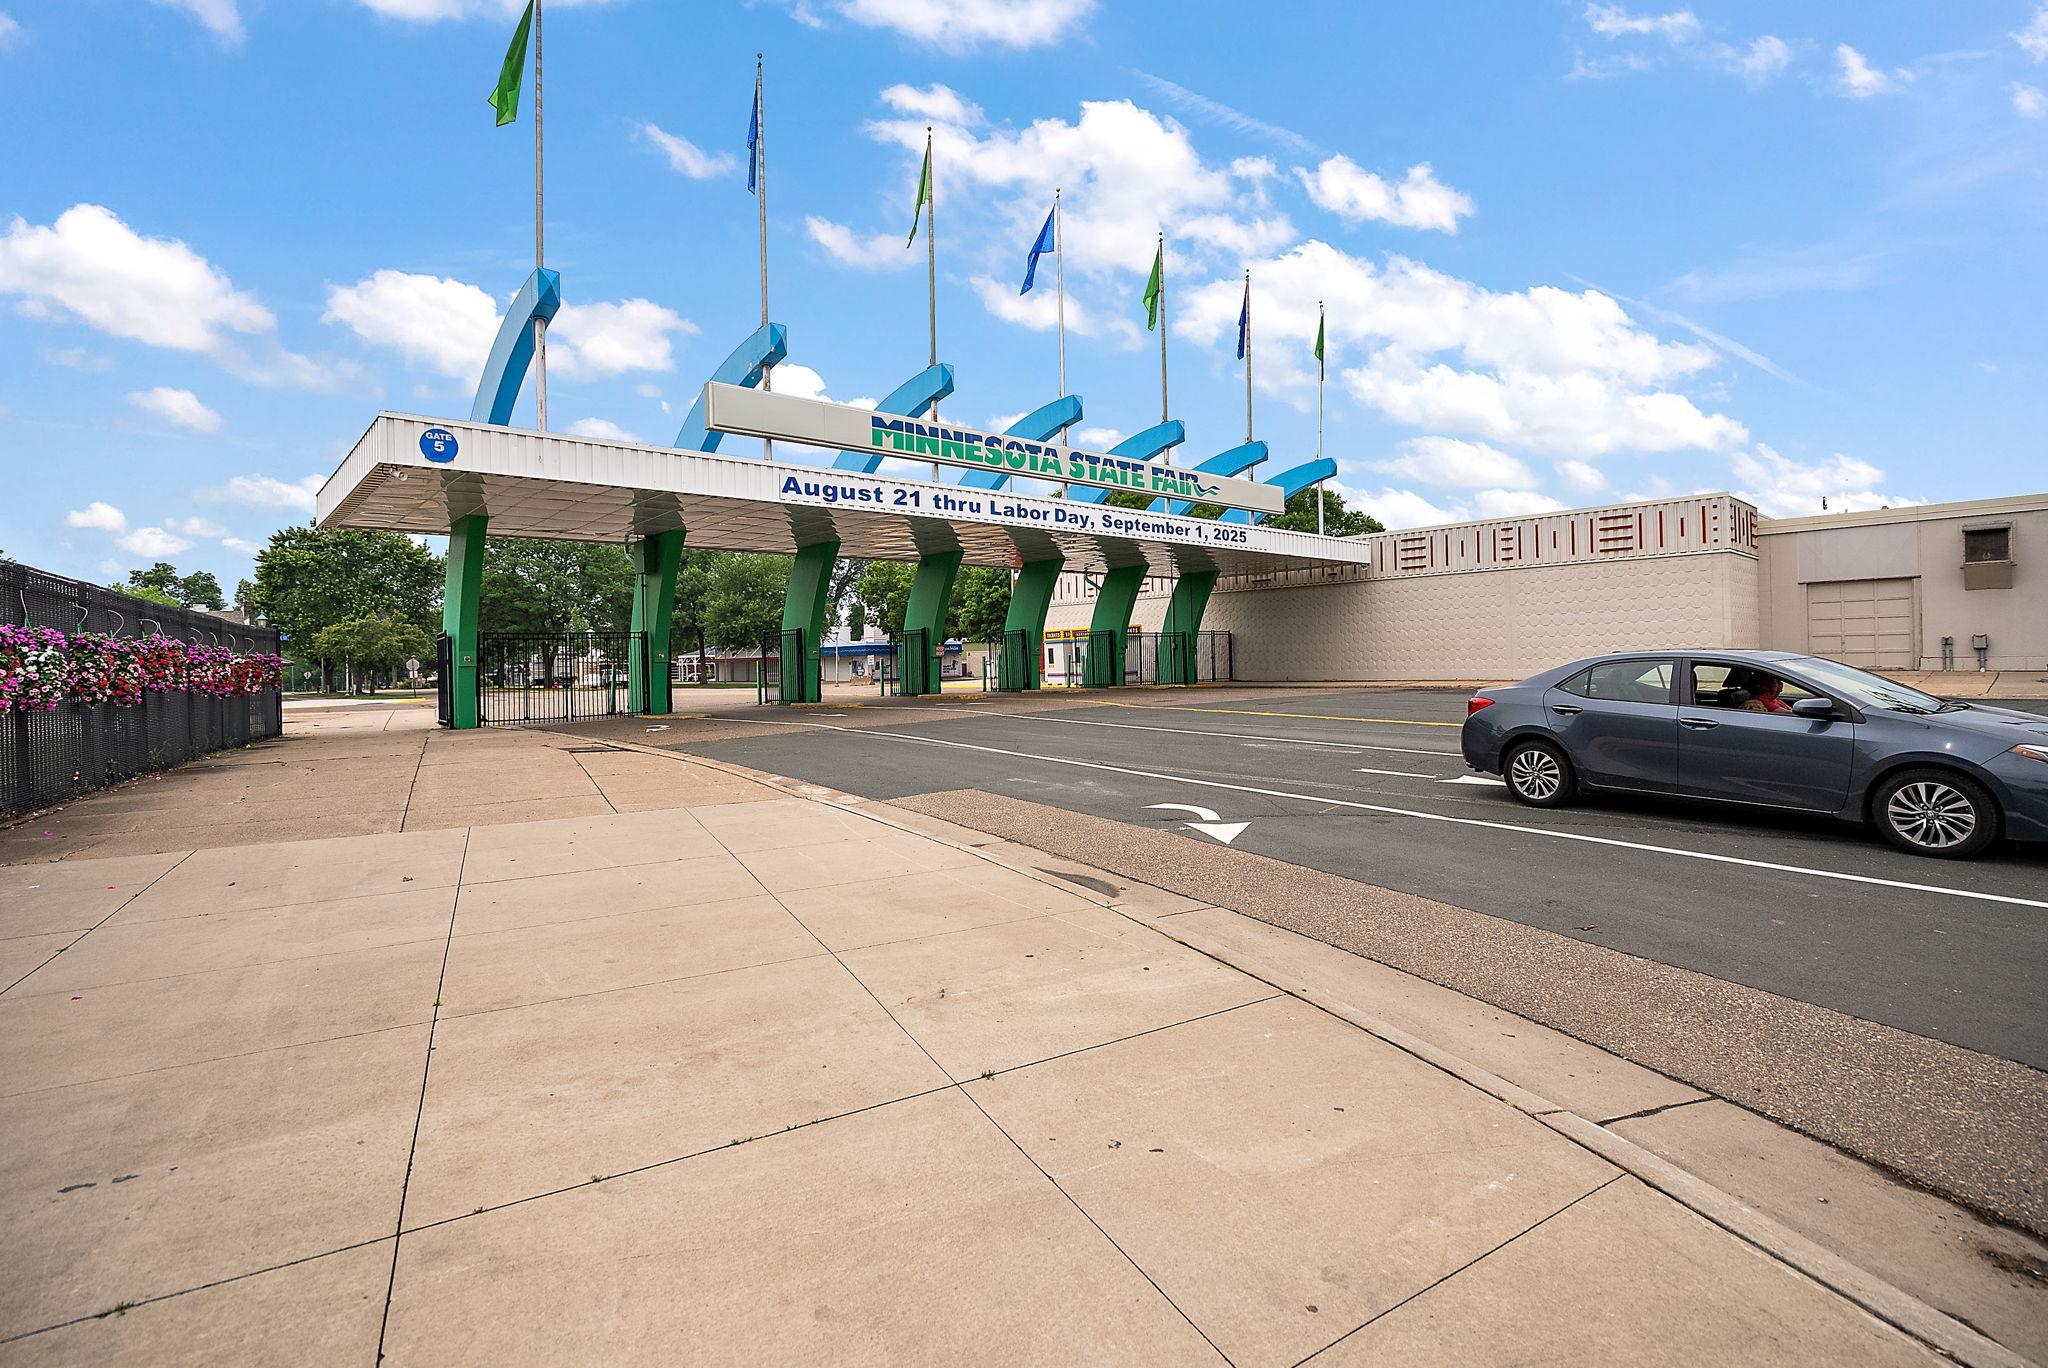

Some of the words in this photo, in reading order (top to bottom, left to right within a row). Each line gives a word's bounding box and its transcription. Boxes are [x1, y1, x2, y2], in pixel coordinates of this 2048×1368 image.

[425, 432, 452, 441] GATE
[434, 441, 445, 452] 5
[872, 416, 1063, 475] MINNESOTA
[1069, 451, 1145, 488] STATE
[1152, 466, 1218, 497] FAIR
[781, 476, 884, 502] August
[893, 489, 921, 507] 21
[932, 494, 981, 513] thru
[990, 500, 1050, 520] Labor
[1055, 508, 1095, 529] Day,
[1102, 514, 1190, 536] September
[1195, 525, 1208, 541] 1,
[1213, 528, 1247, 543] 2025
